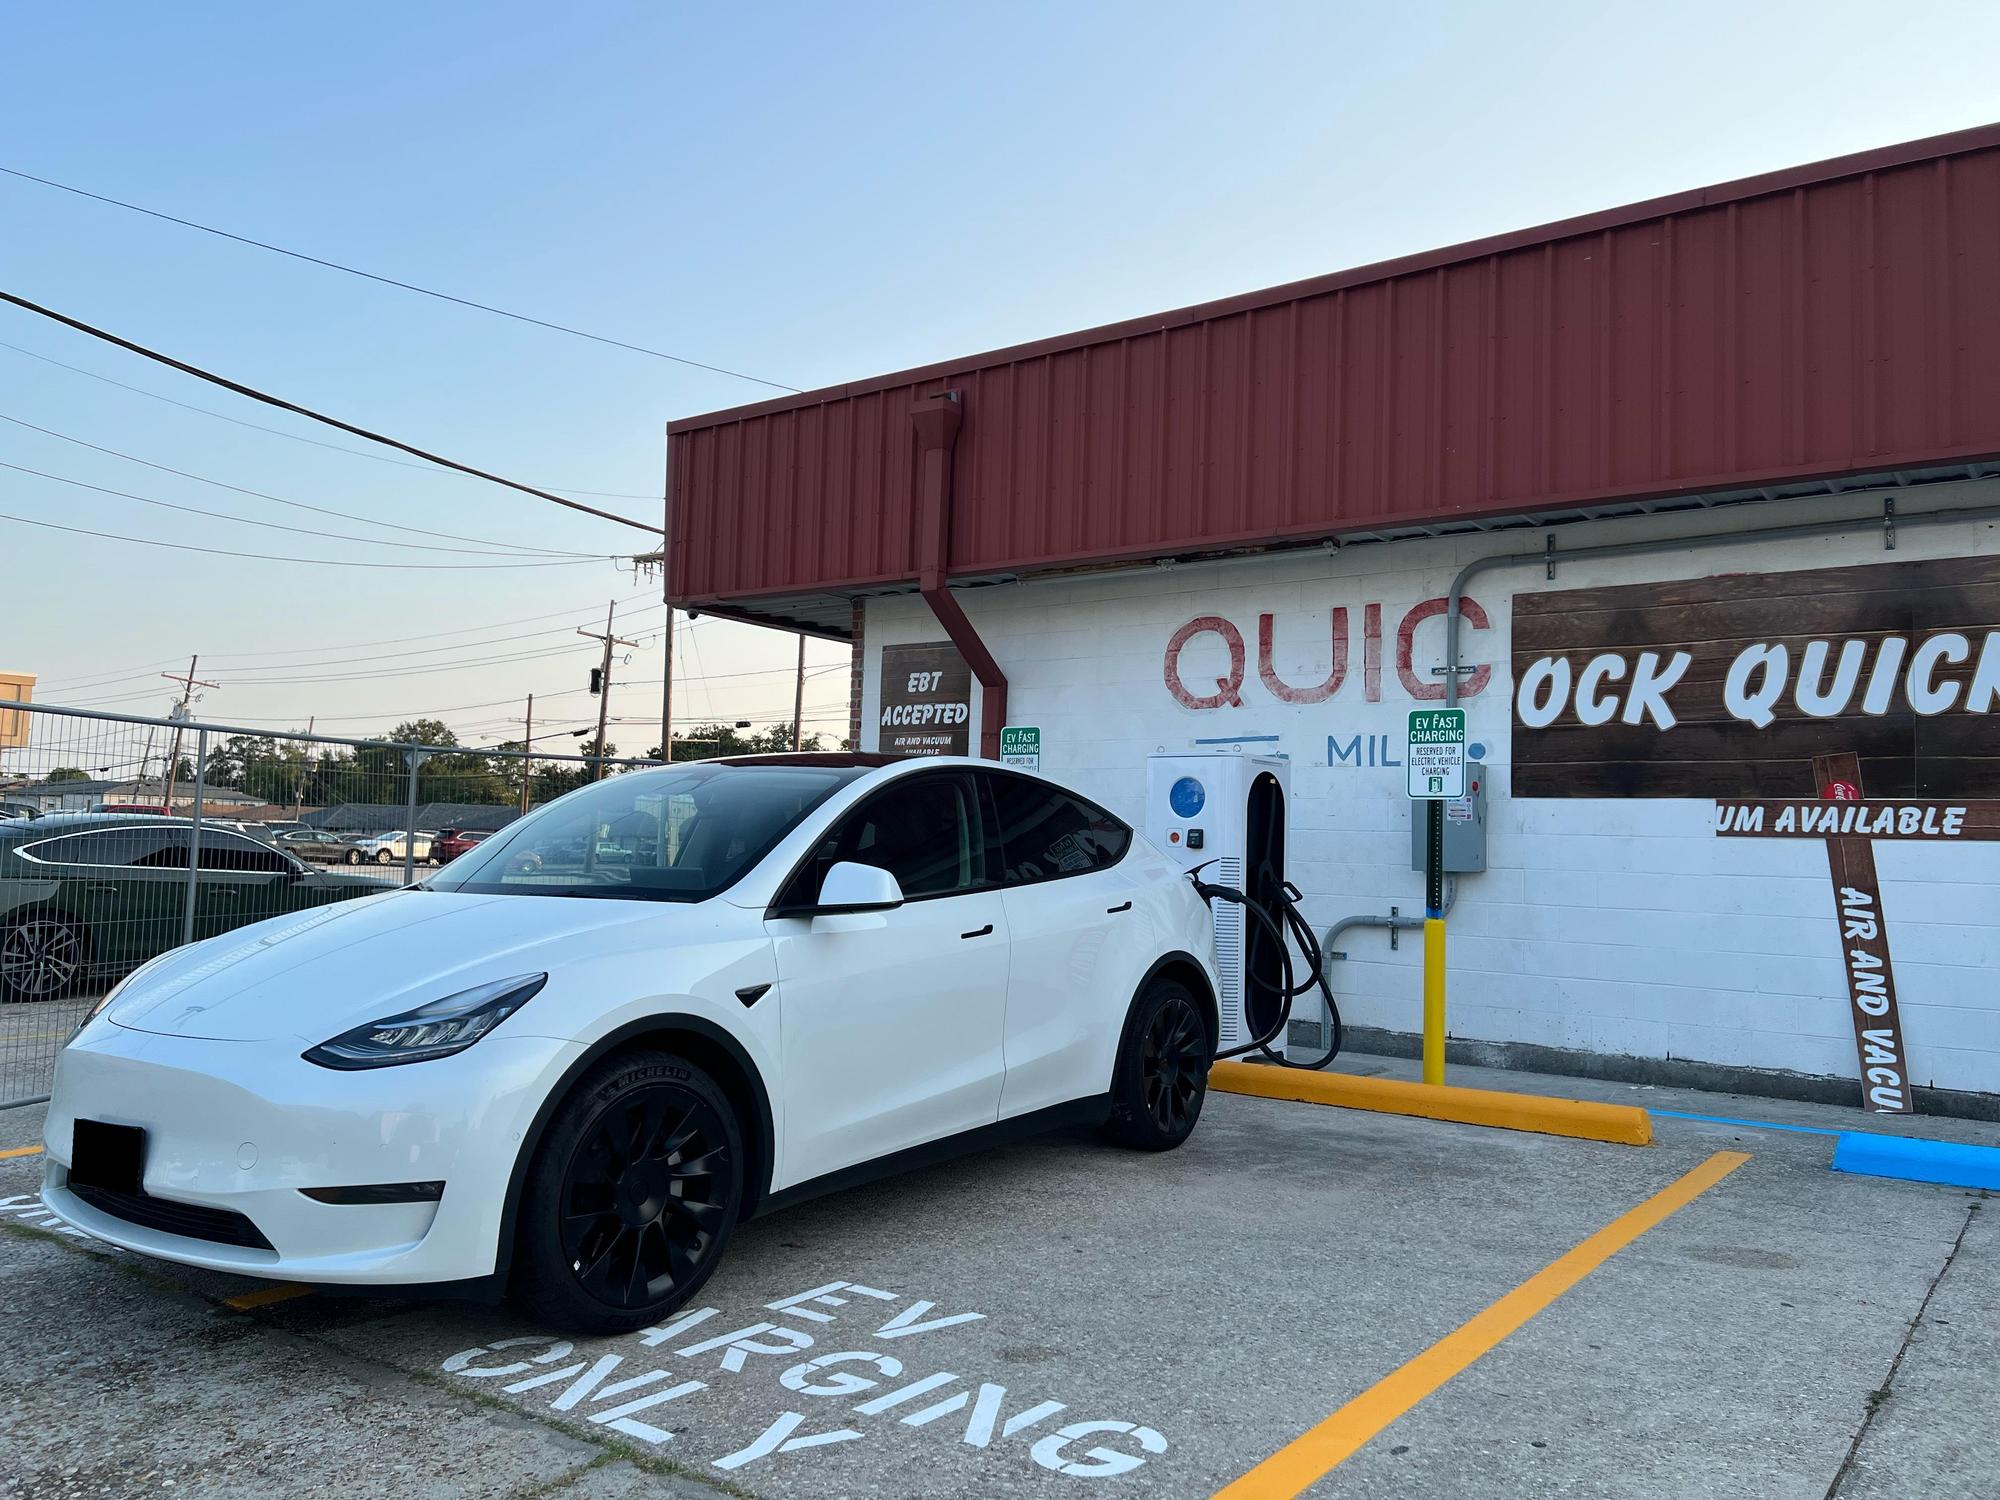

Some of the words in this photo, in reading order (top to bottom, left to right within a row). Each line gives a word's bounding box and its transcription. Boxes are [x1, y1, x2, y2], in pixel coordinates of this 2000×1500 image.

[1163, 596, 1491, 710] QUIC
[907, 671, 943, 693] EBT
[1516, 651, 1693, 731] OCK
[881, 703, 968, 726] ACCEPTED
[1416, 717, 1430, 729] EV
[1432, 716, 1458, 729] FAST
[894, 737, 906, 746] AIR
[906, 737, 921, 745] AND
[922, 736, 952, 745] VACUUM
[1006, 733, 1017, 743] EV
[1018, 732, 1036, 743] FAST
[1410, 729, 1464, 742] CHARGING
[1002, 743, 1039, 754] CHARGING
[1327, 735, 1401, 767] MIL
[1416, 746, 1444, 756] RESERVED
[1445, 746, 1457, 755] FOR
[1411, 757, 1438, 766] ELECTRIC
[1438, 756, 1461, 766] VEHICLE
[1421, 766, 1450, 776] CHARGING
[1715, 805, 1765, 833] UM
[1774, 805, 1967, 835] AVAILABLE
[1840, 886, 1878, 940] AIR
[1850, 949, 1890, 1017] AND
[618, 1066, 689, 1088] MICHELIN
[1862, 1029, 1904, 1110] VACU
[764, 1280, 986, 1339] EV
[442, 1335, 865, 1470] ONLY
